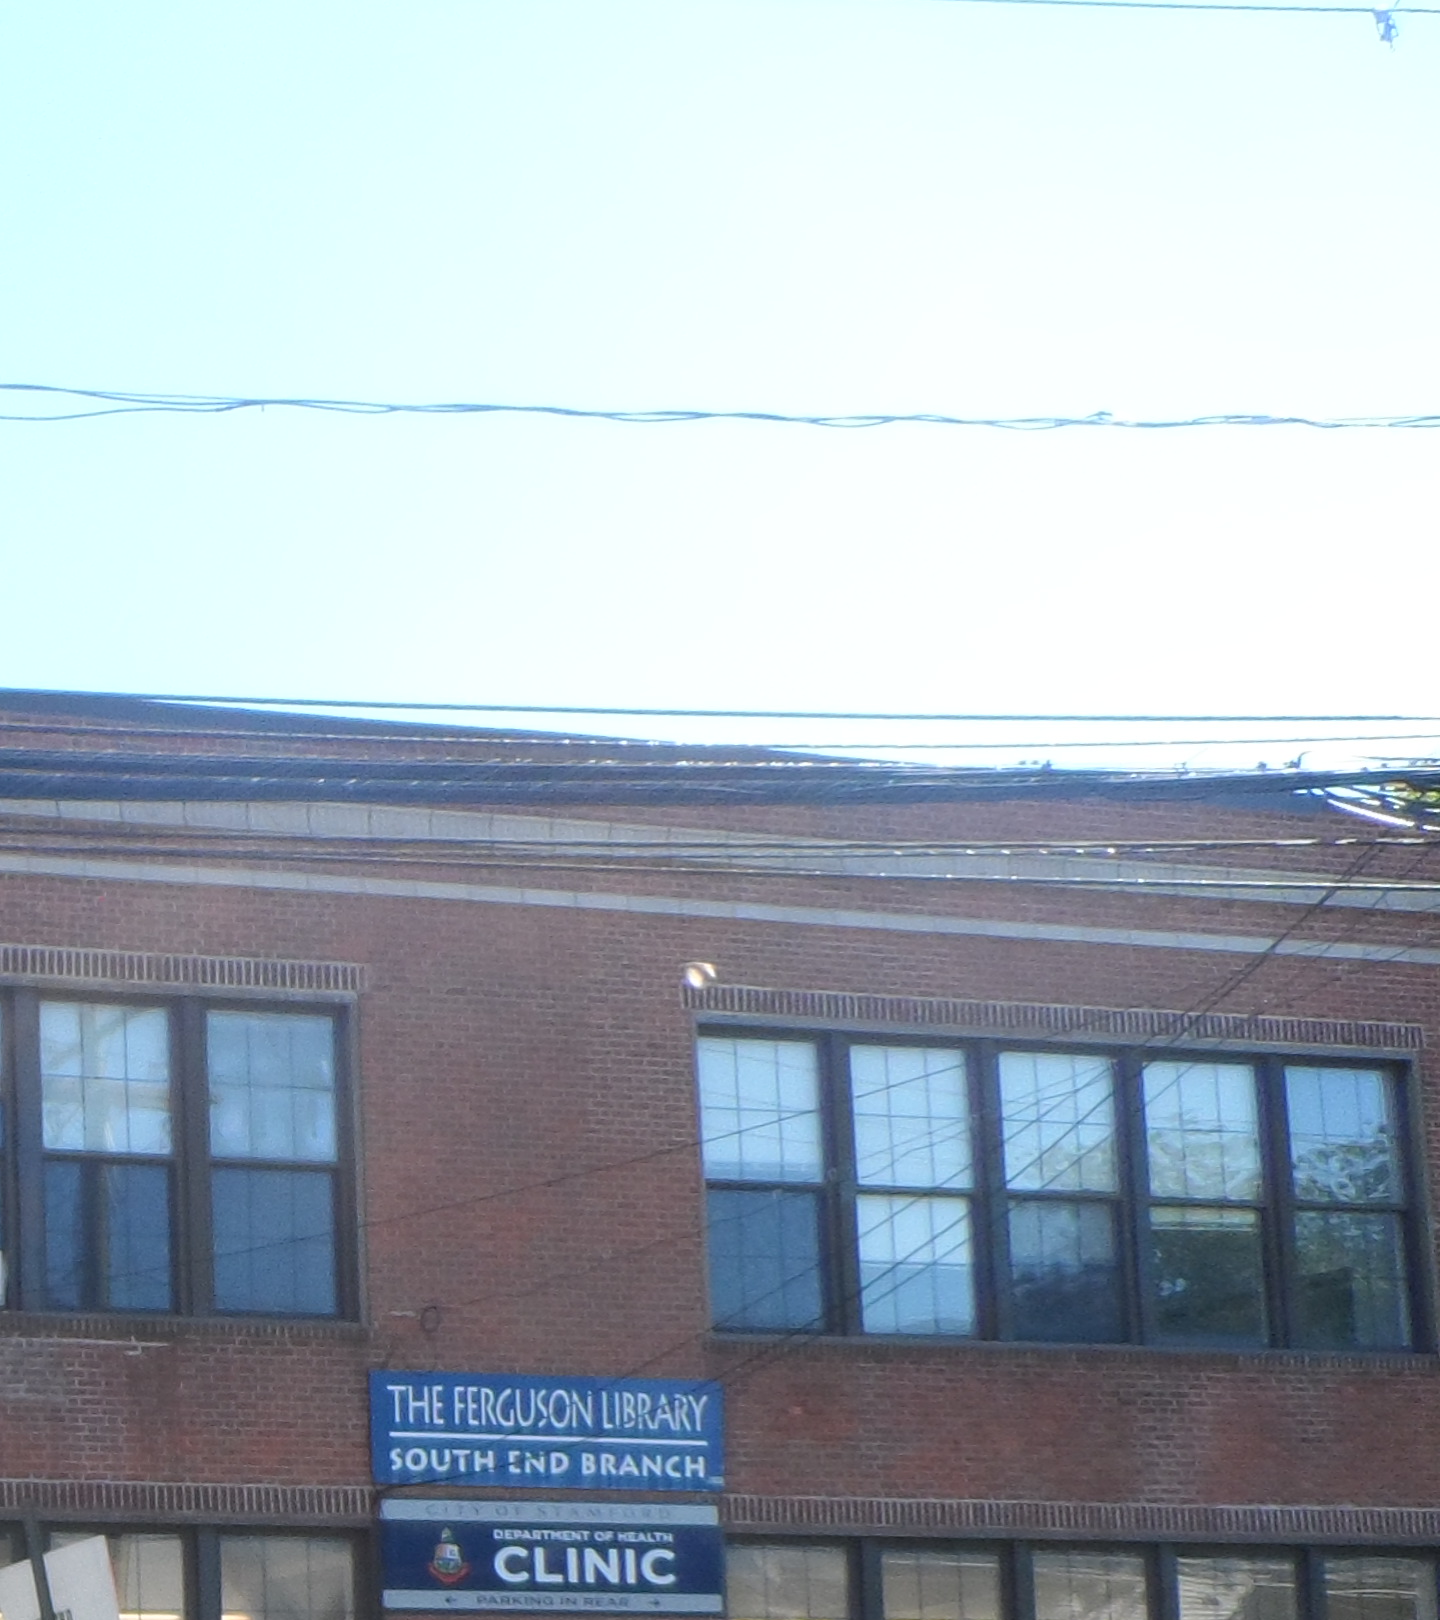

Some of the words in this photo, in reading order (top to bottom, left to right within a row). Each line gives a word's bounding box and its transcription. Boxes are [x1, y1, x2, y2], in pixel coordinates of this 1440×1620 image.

[387, 1384, 444, 1425] THE
[454, 1386, 594, 1429] FERGUSON
[602, 1391, 708, 1432] LIBRARY
[389, 1448, 496, 1474] SOUTH
[508, 1450, 570, 1475] END
[580, 1452, 707, 1479] BRANCH
[424, 1504, 482, 1517] CITY
[495, 1505, 522, 1517] OF
[536, 1505, 673, 1519] STAMFORD
[492, 1528, 590, 1542] DEPARTMENT
[594, 1530, 615, 1542] OF
[617, 1531, 674, 1544] HEALTH
[494, 1545, 677, 1585] CLINIC
[476, 1594, 554, 1607] PARKING
[559, 1595, 576, 1608] IN
[582, 1596, 631, 1608] REAR
